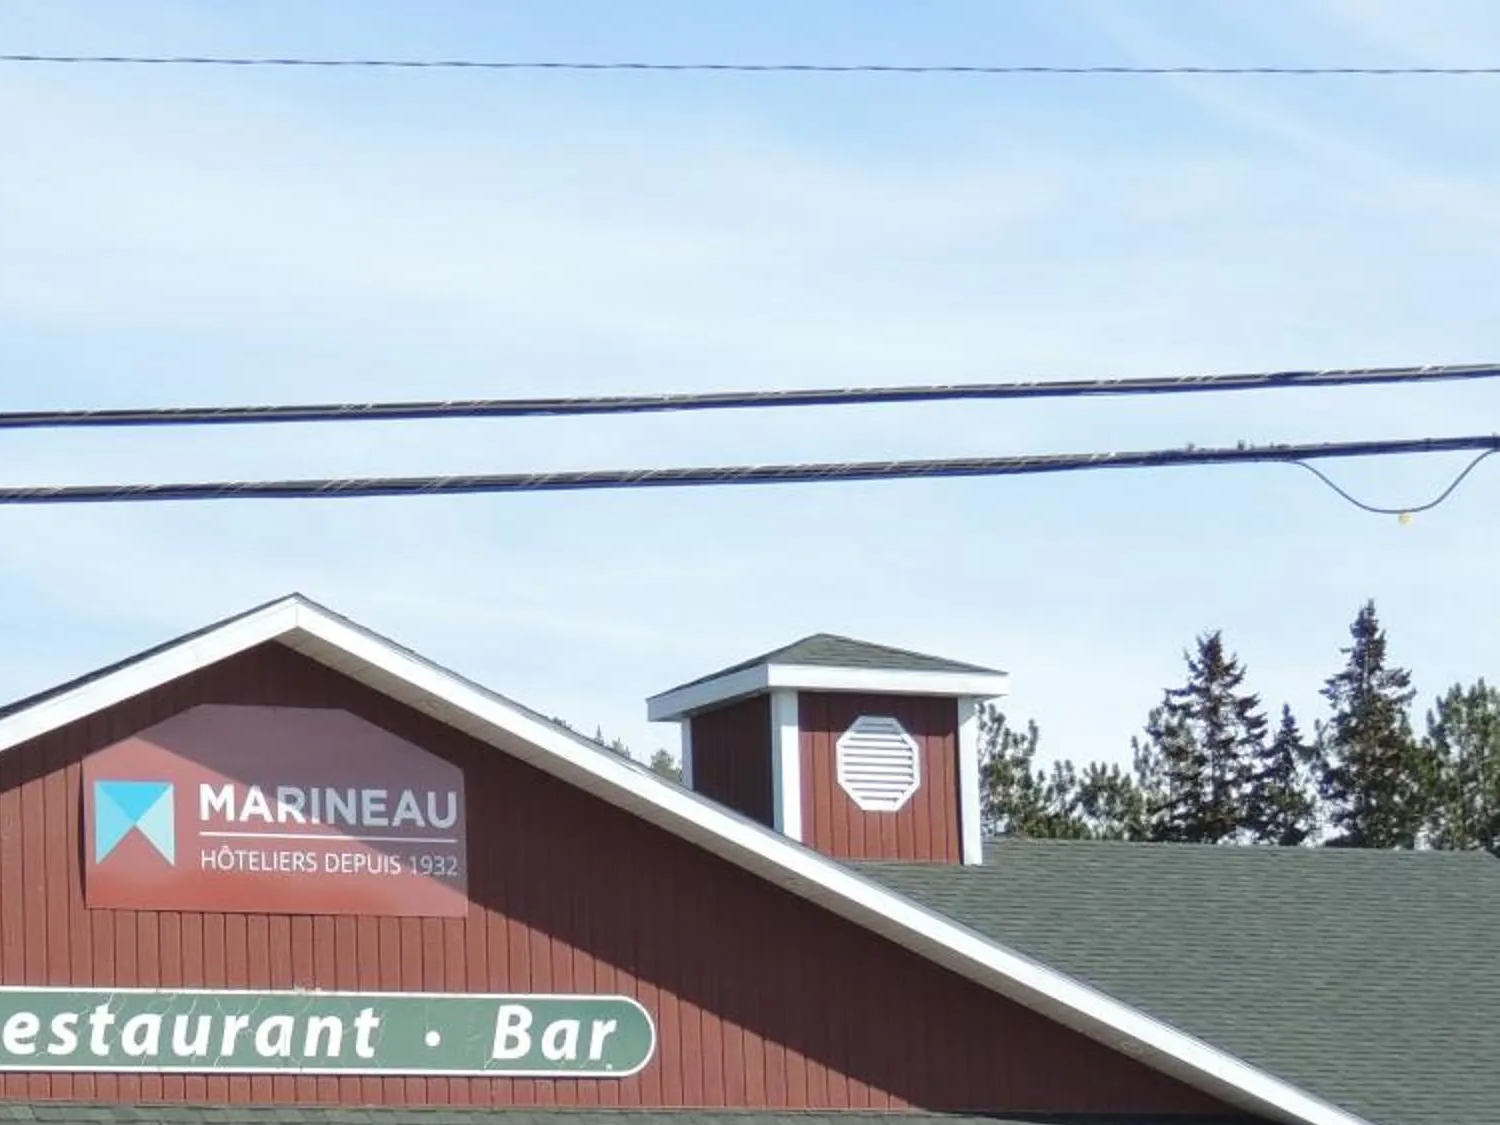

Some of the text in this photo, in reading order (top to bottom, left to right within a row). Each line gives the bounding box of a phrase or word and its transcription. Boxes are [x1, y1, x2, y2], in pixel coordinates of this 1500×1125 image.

[199, 783, 457, 830] MARINEAU
[200, 845, 458, 877] HÔTELIERS DEPUIS 1932
[492, 1004, 617, 1061] Bar
